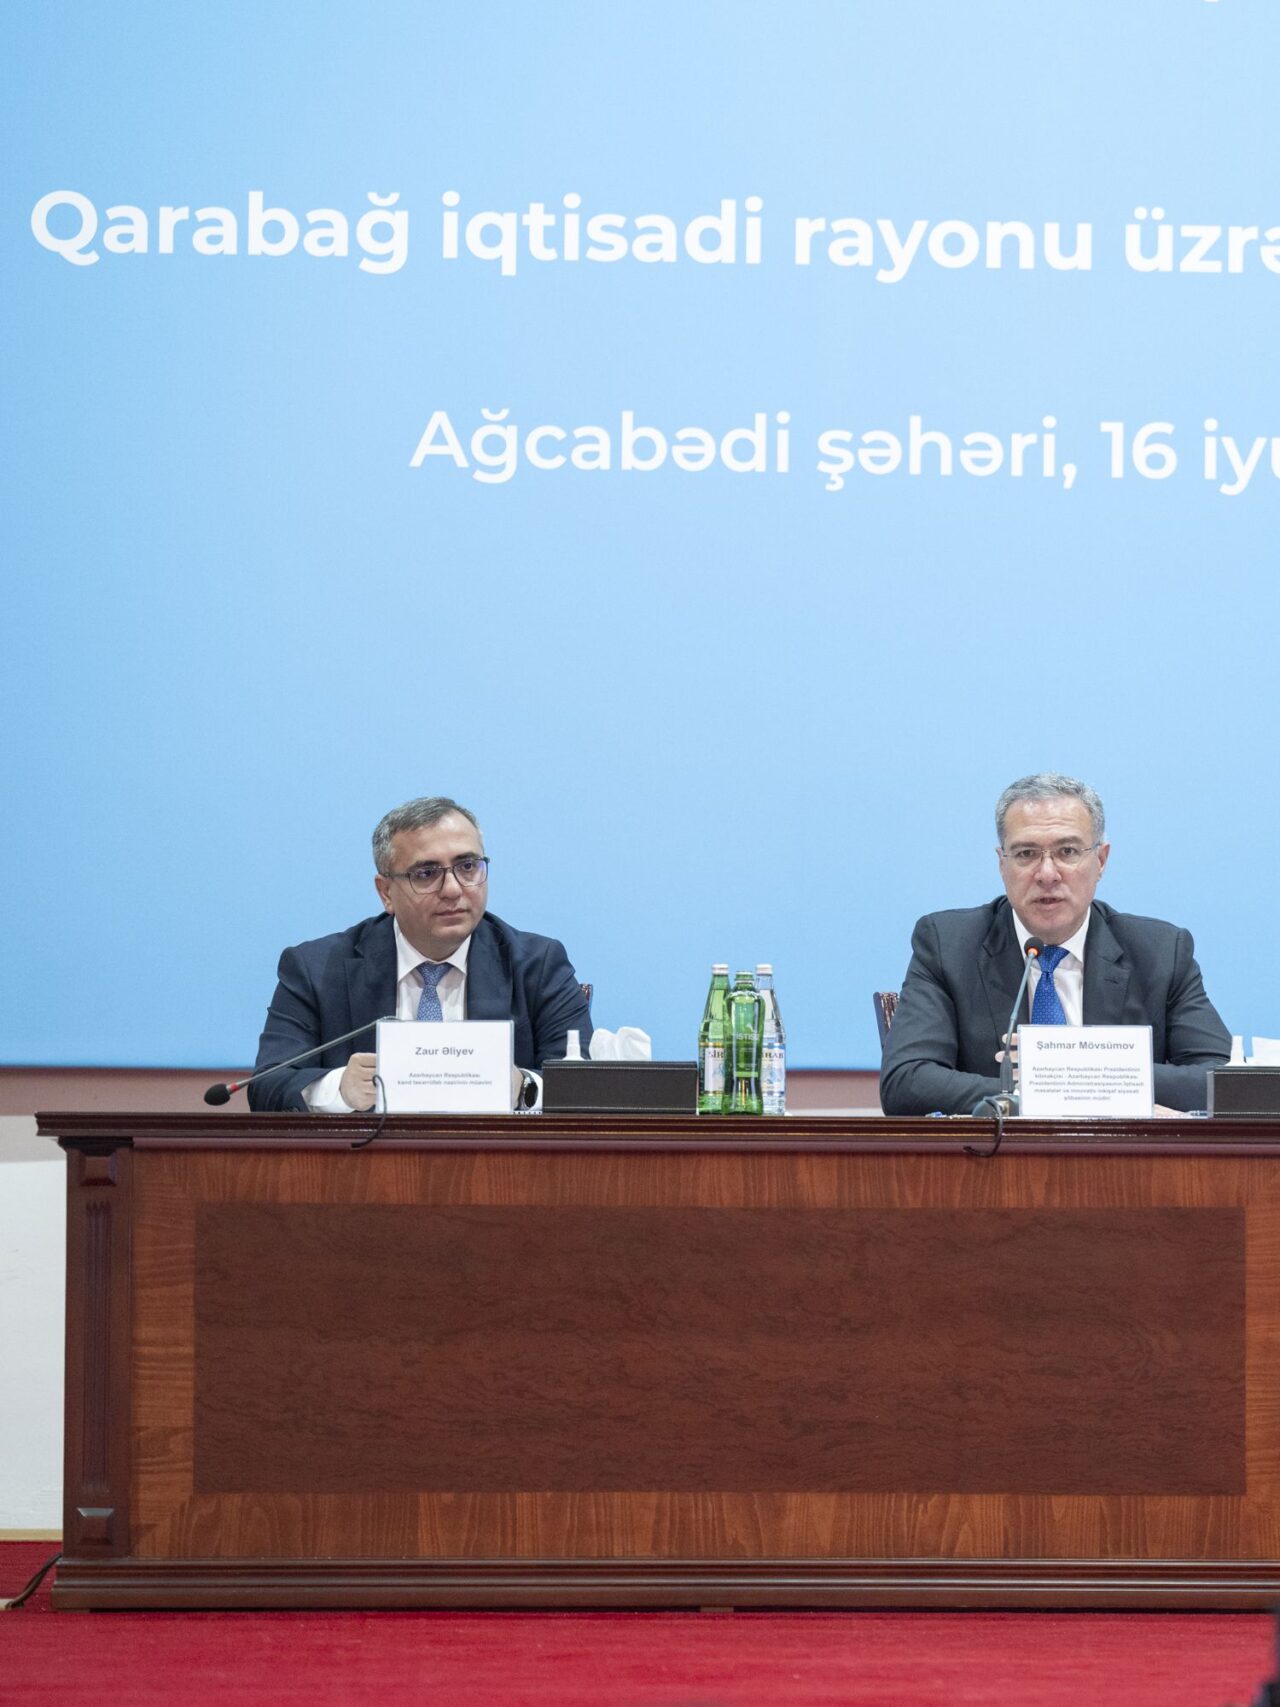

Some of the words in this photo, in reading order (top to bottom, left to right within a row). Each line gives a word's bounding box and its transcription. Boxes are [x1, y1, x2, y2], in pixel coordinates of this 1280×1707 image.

[31, 190, 410, 275] Qarabağ
[441, 190, 764, 277] iqtisadi
[794, 217, 1093, 284] rayonu
[409, 407, 791, 485] Ağcabədi
[816, 414, 1078, 492] şəhəri,
[1099, 420, 1178, 481] 16
[415, 1046, 439, 1055] Zaur
[442, 1046, 474, 1057] Əliyev
[1036, 1040, 1077, 1050] Şahmar
[1079, 1041, 1135, 1050] Mövsümov
